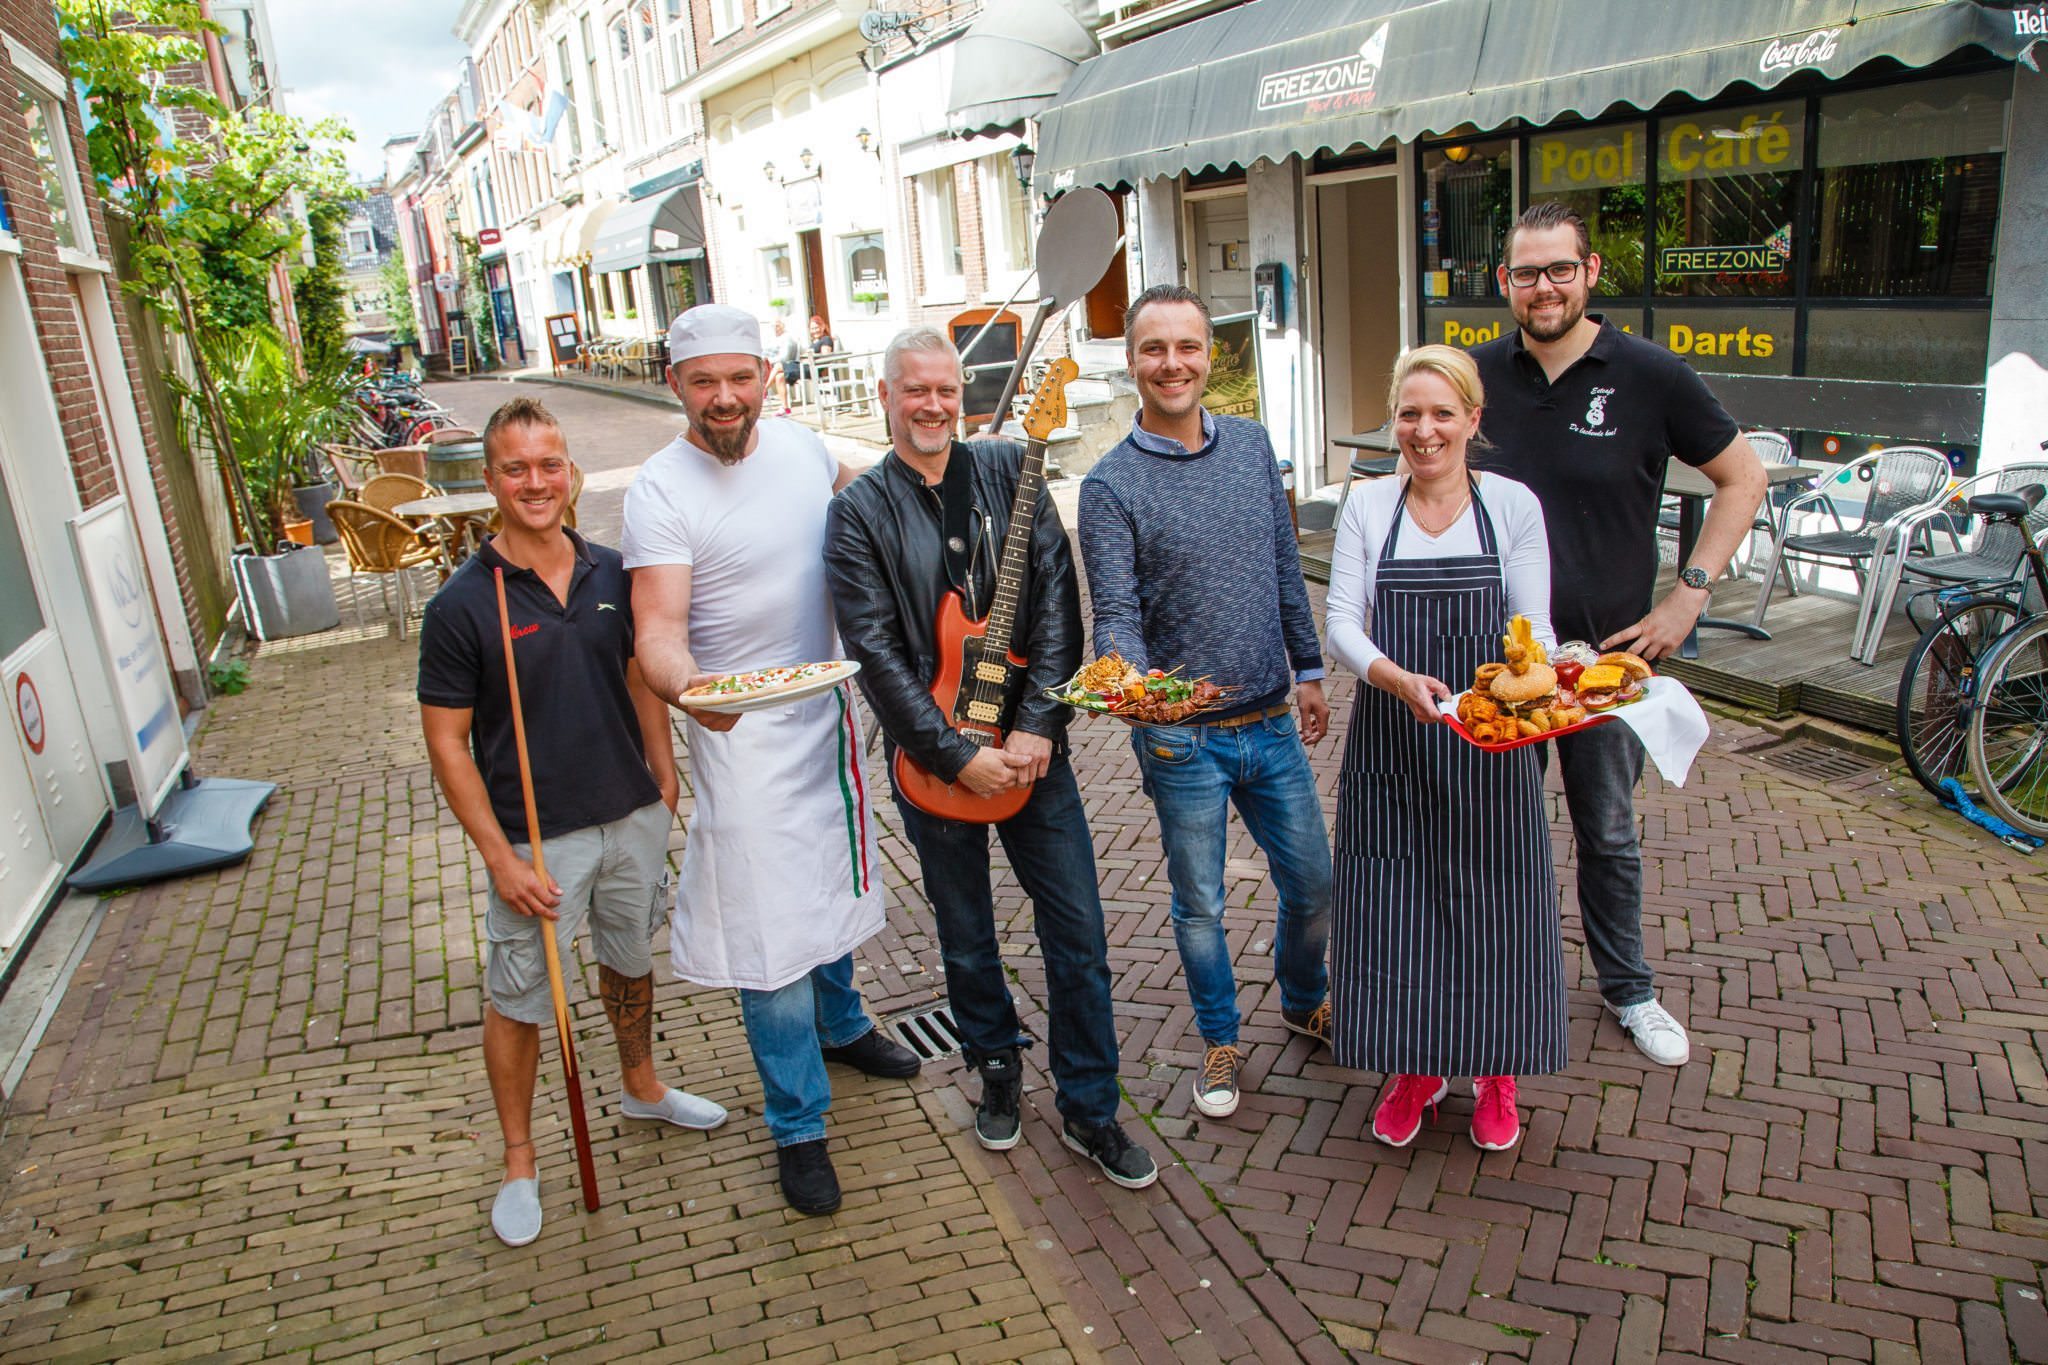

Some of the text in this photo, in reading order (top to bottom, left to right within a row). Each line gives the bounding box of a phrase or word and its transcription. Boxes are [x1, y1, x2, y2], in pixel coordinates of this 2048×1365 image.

[2012, 8, 2048, 35] Hei
[1261, 61, 1373, 104] FREEZONE
[1541, 111, 1791, 185] Pool Café
[1665, 250, 1781, 269] FREEZONE
[1444, 321, 1500, 346] Pool
[1669, 325, 1774, 357] Darts
